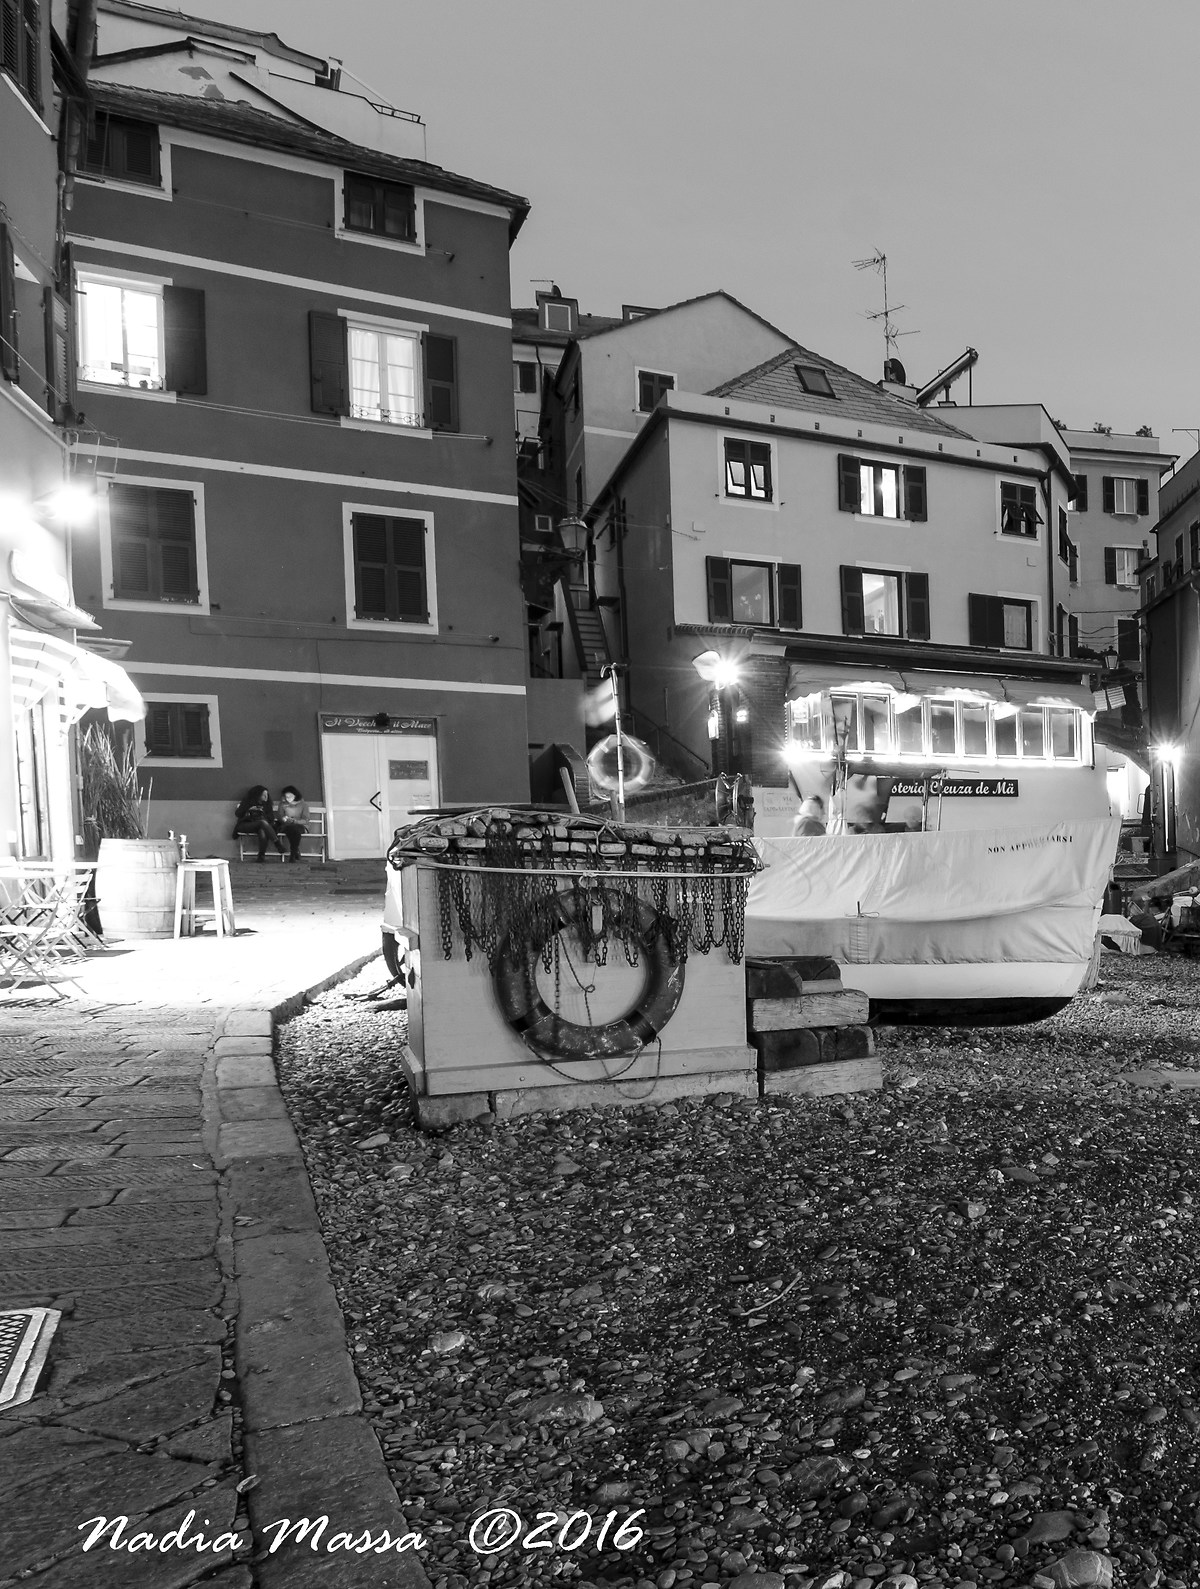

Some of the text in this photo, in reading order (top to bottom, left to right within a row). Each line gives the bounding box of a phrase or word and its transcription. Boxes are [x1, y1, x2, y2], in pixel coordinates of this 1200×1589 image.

[344, 717, 377, 728] Vecch
[891, 780, 1016, 795] steria Ceuza de Mä
[987, 845, 1006, 854] NON
